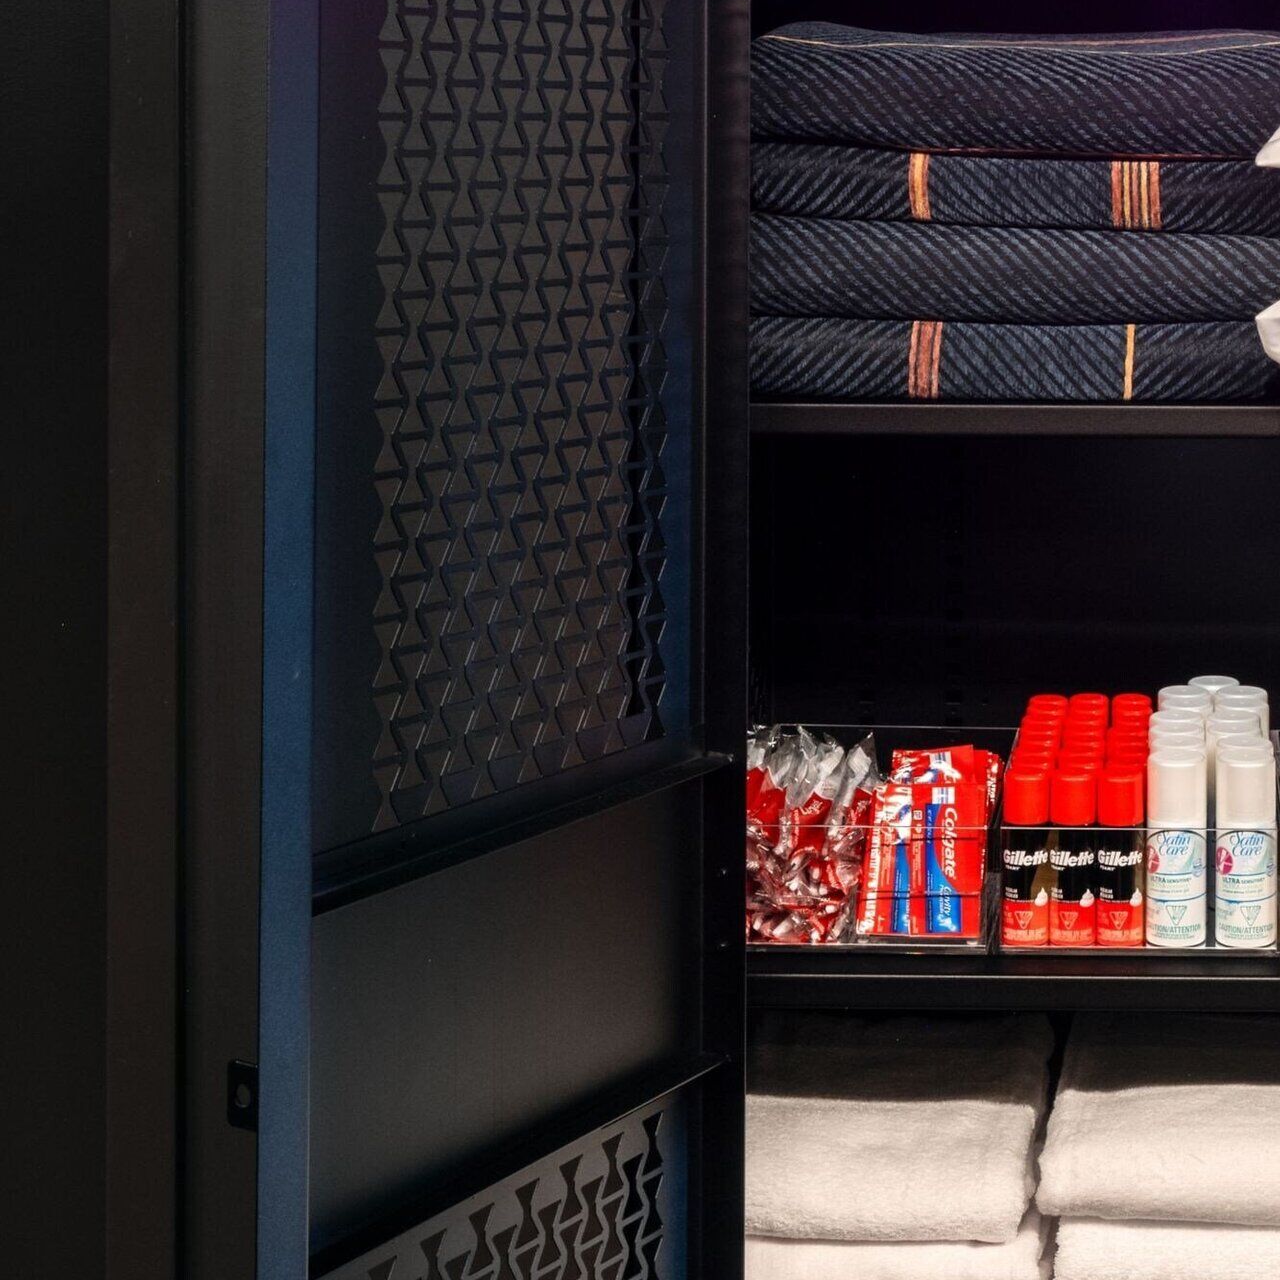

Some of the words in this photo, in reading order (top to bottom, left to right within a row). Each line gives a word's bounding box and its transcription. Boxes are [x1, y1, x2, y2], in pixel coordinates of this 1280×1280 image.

[942, 807, 958, 878] Colgate
[1157, 830, 1191, 846] Satin
[1229, 830, 1264, 847] Satin
[1003, 849, 1049, 867] Gillette
[1049, 849, 1095, 867] Gillette
[1097, 849, 1143, 867] Gillette
[1158, 845, 1189, 857] Care
[1231, 845, 1263, 857] Care
